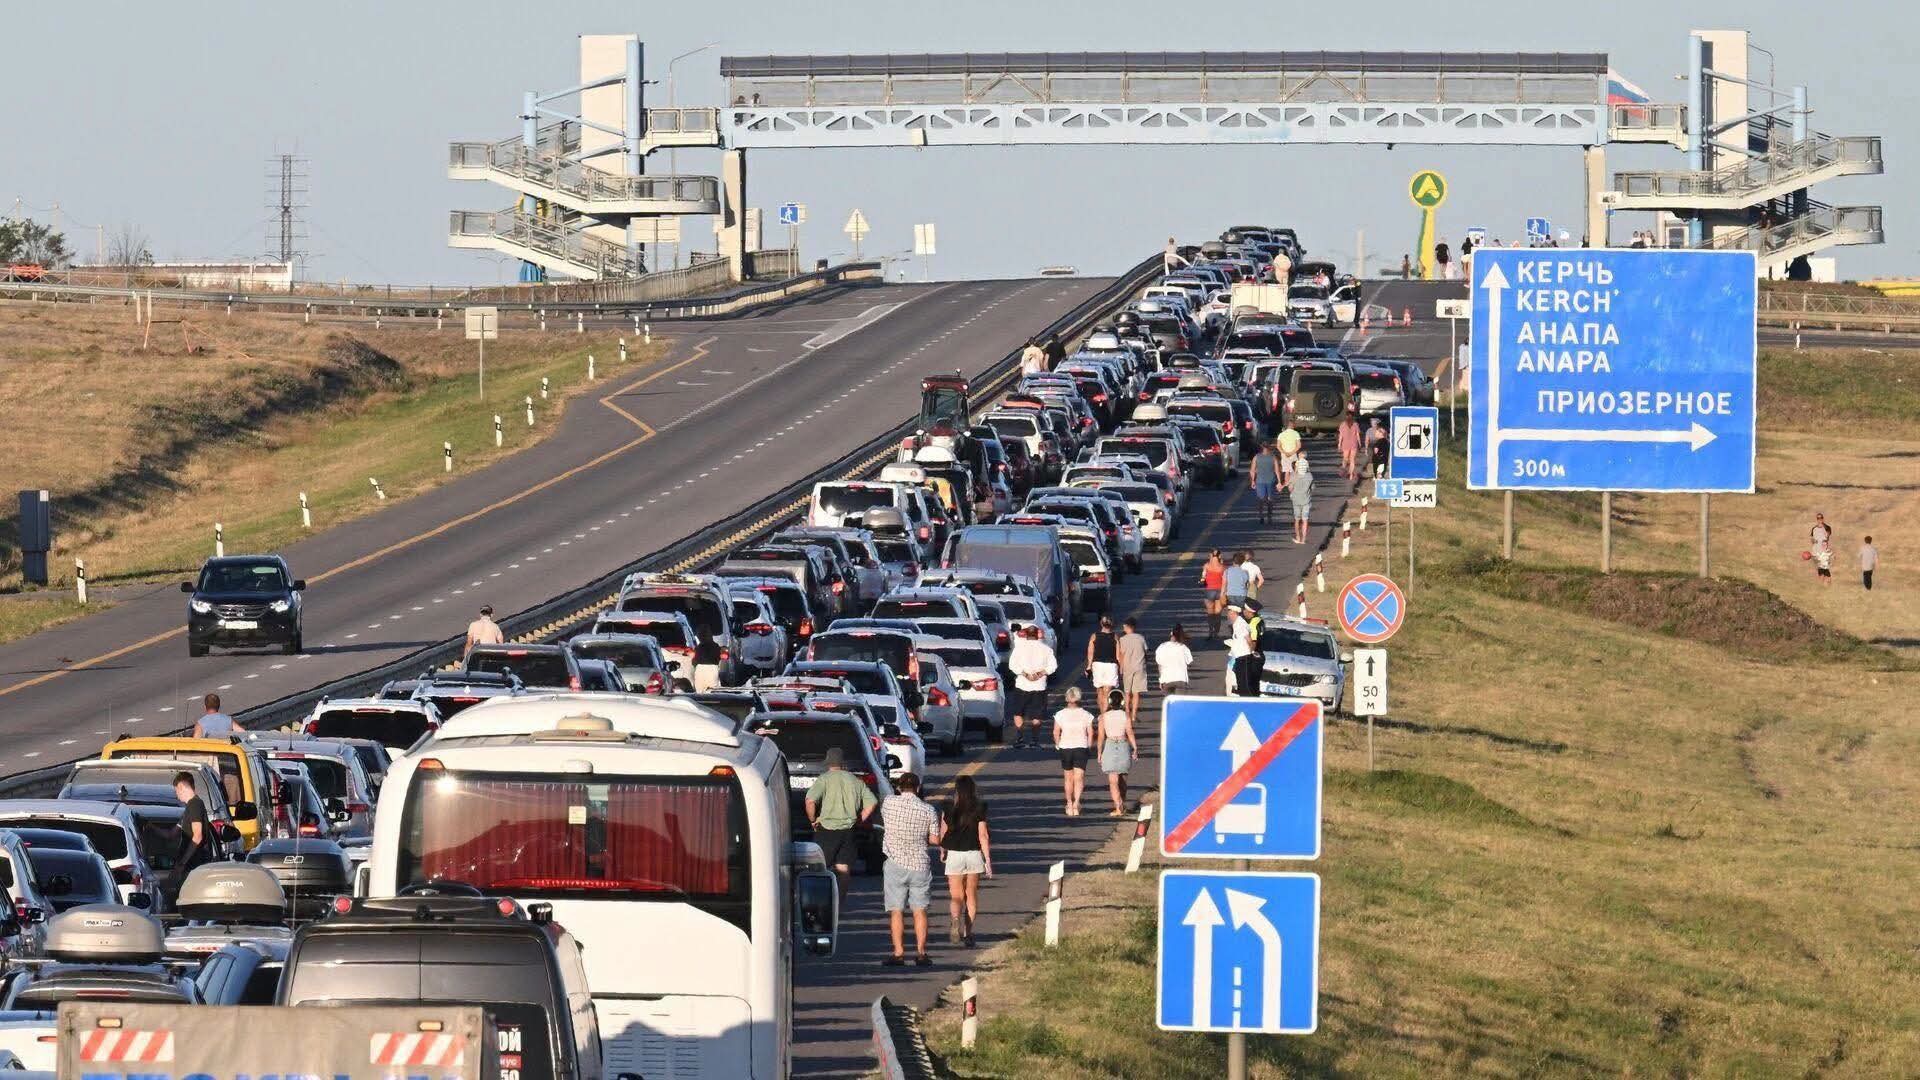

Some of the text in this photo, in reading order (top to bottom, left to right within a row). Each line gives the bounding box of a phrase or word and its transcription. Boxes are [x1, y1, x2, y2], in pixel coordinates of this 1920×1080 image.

[1517, 261, 1614, 285] КЕРЧЬ
[1516, 322, 1620, 345] АНАПА
[1516, 350, 1611, 373] ANAPA
[1537, 390, 1732, 415] ПРИОЗЕРНОЕ
[1381, 483, 1398, 496] 13
[1363, 685, 1378, 697] 50
